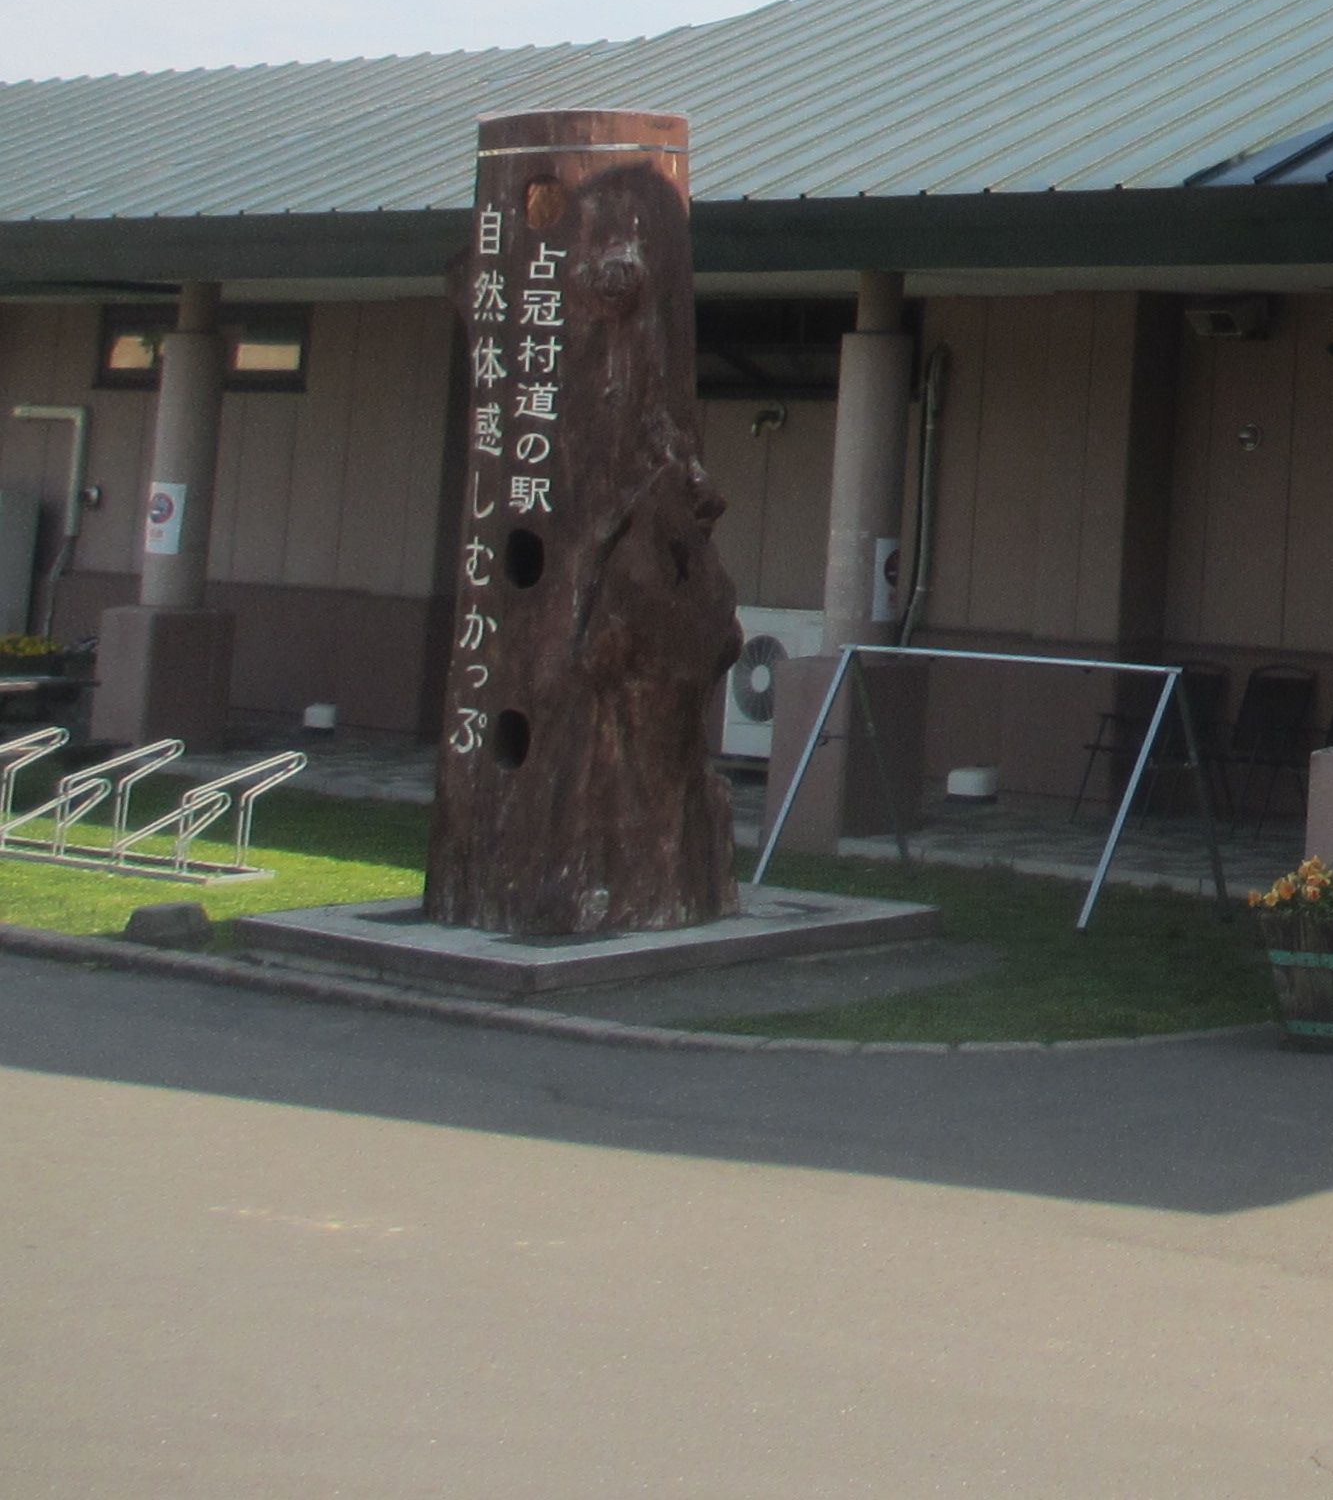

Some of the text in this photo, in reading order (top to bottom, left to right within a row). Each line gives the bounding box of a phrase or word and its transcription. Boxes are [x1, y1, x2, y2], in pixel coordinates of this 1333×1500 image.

[450, 202, 508, 754] 自然体感しむかっぷ
[509, 242, 567, 514] 占冠村道の駅
